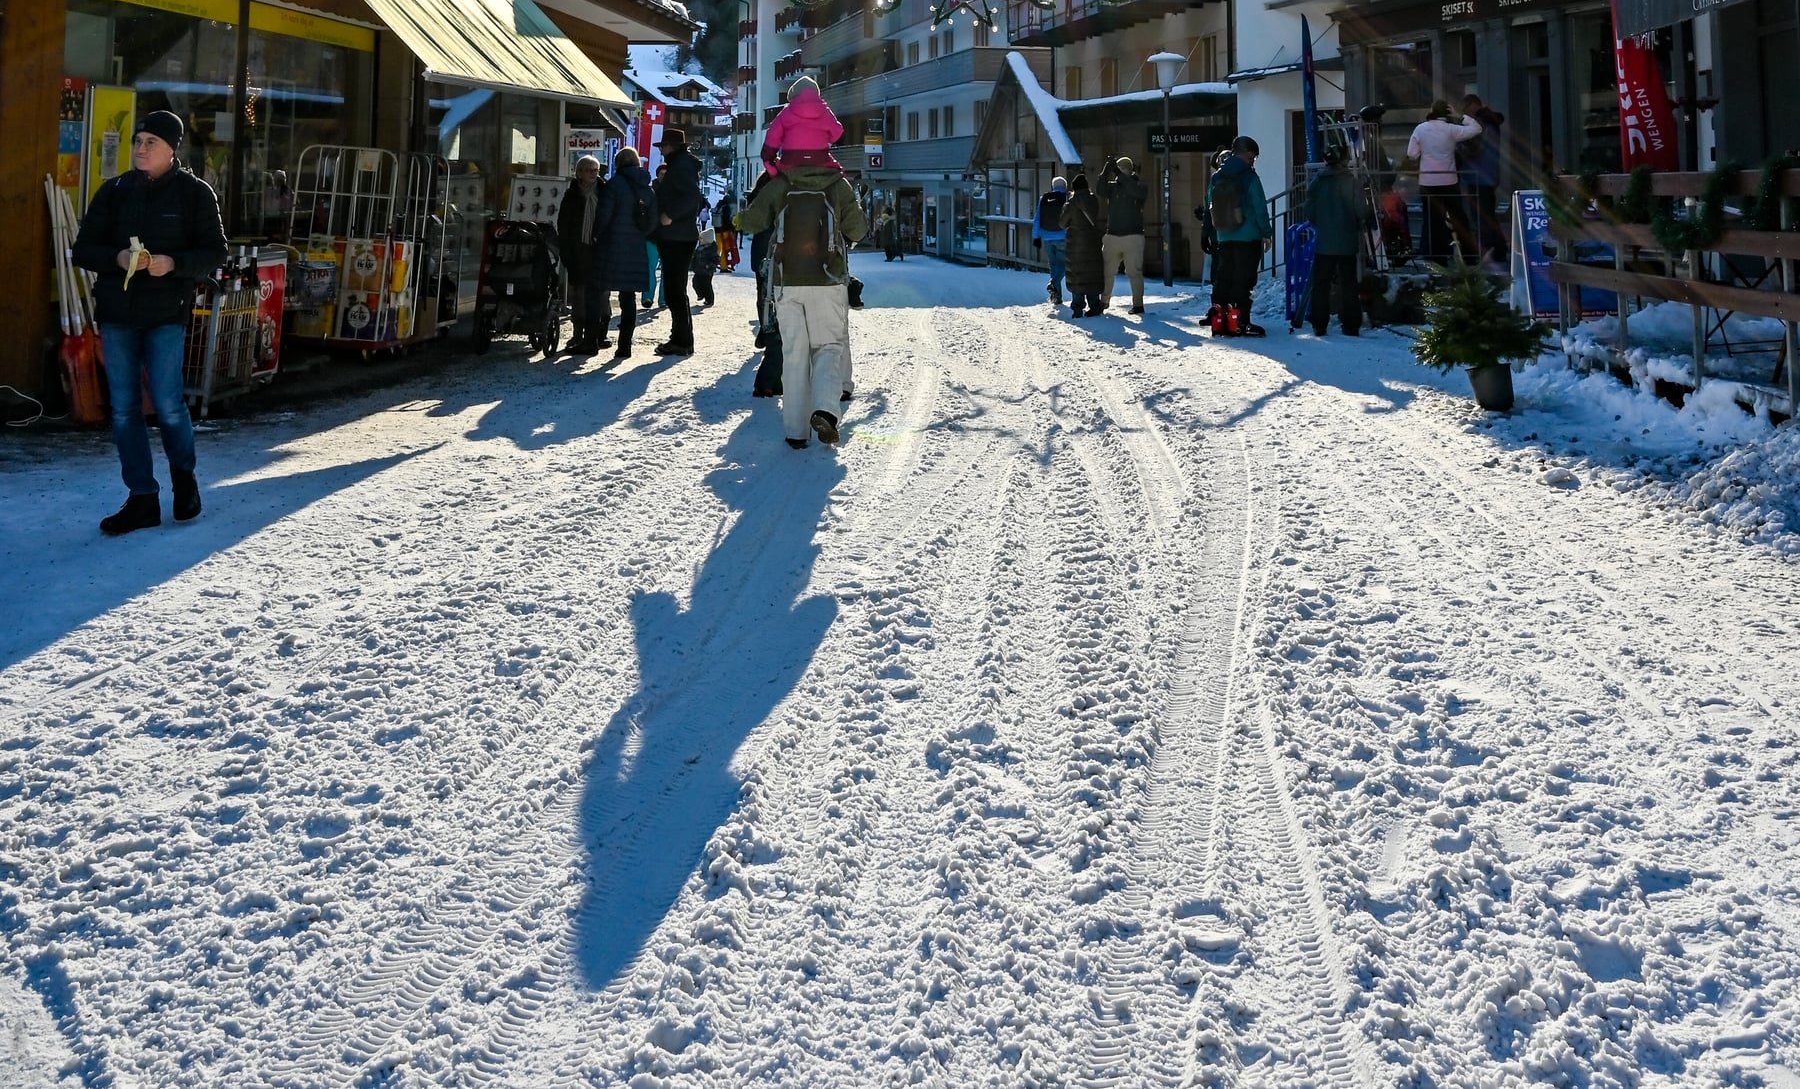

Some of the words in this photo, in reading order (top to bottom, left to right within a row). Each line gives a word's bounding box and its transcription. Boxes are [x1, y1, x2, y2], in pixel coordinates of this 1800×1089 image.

[1441, 1, 1466, 16] SKISET
[1637, 89, 1664, 151] WENGEN
[579, 139, 600, 149] Sport
[1181, 134, 1200, 143] MORE
